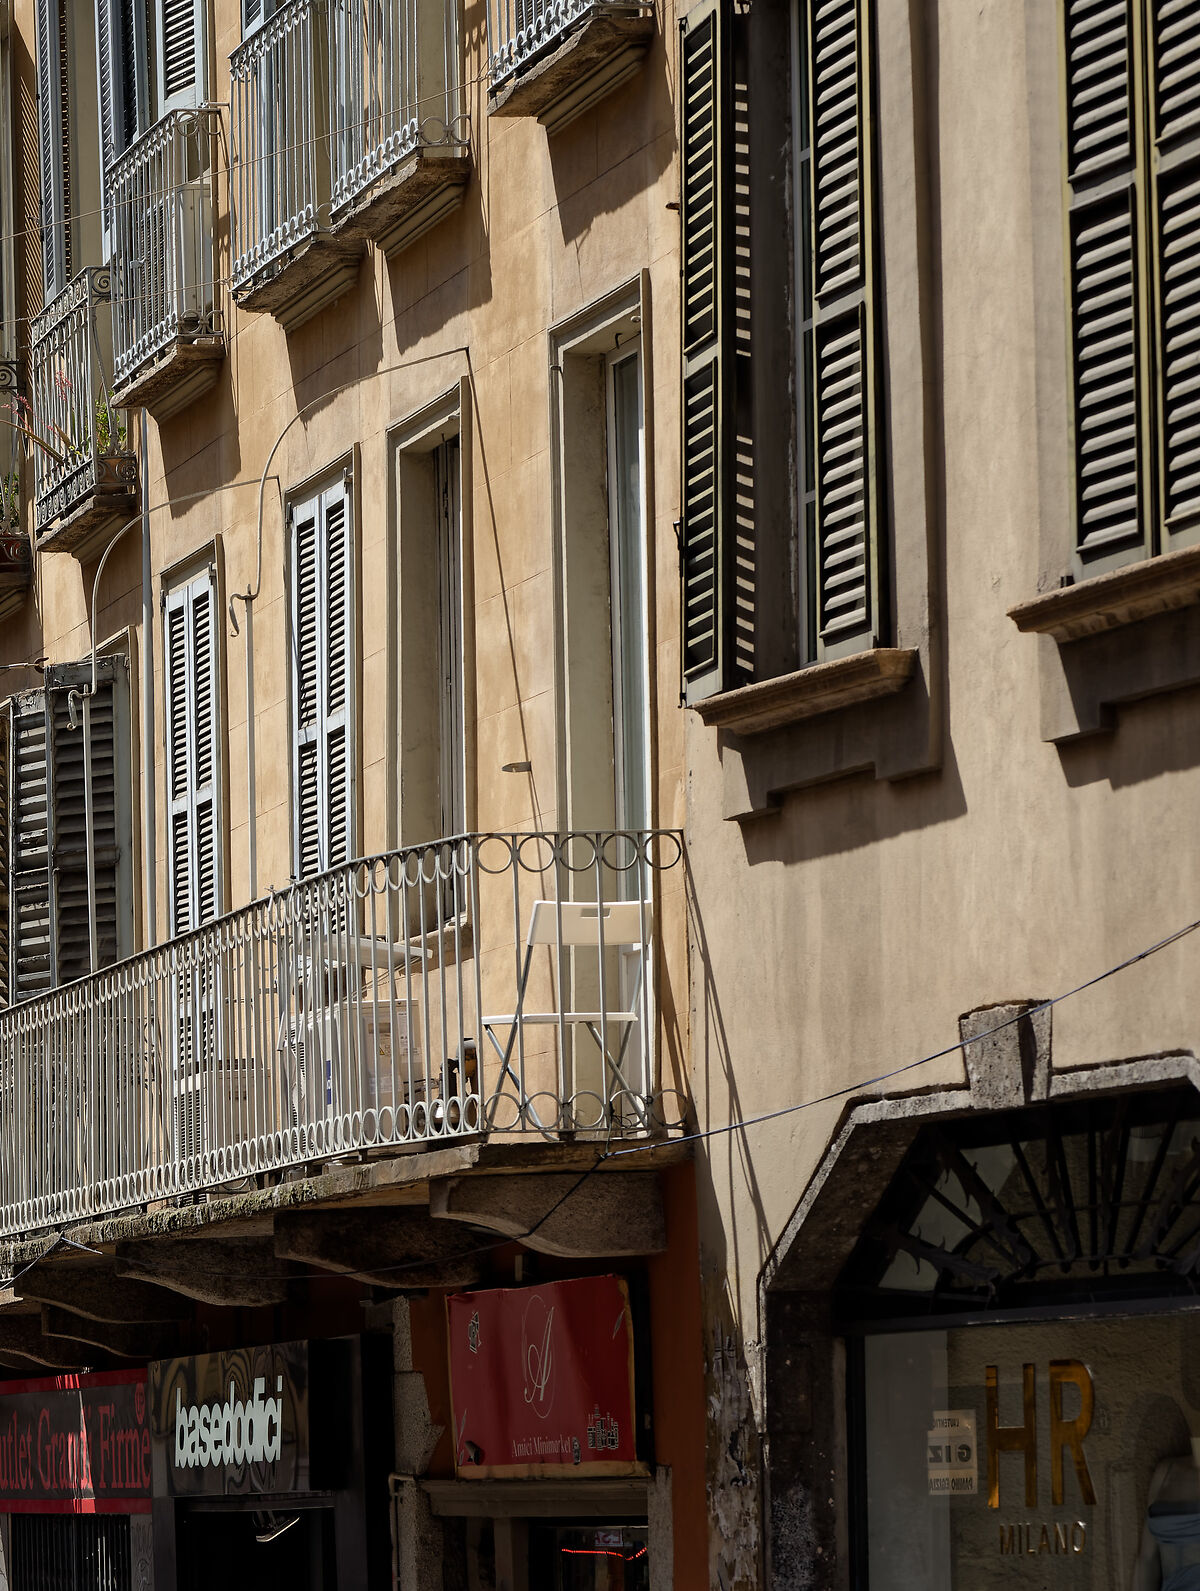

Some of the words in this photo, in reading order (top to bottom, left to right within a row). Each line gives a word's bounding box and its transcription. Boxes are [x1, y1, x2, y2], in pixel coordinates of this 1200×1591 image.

[37, 1407, 94, 1490] Grandi
[98, 1403, 152, 1489] Firme
[175, 1375, 282, 1469] basedodici
[511, 1440, 532, 1458] Amici
[533, 1434, 571, 1457] Minimarket
[986, 1359, 1097, 1508] HR
[1000, 1521, 1086, 1555] MILANO
